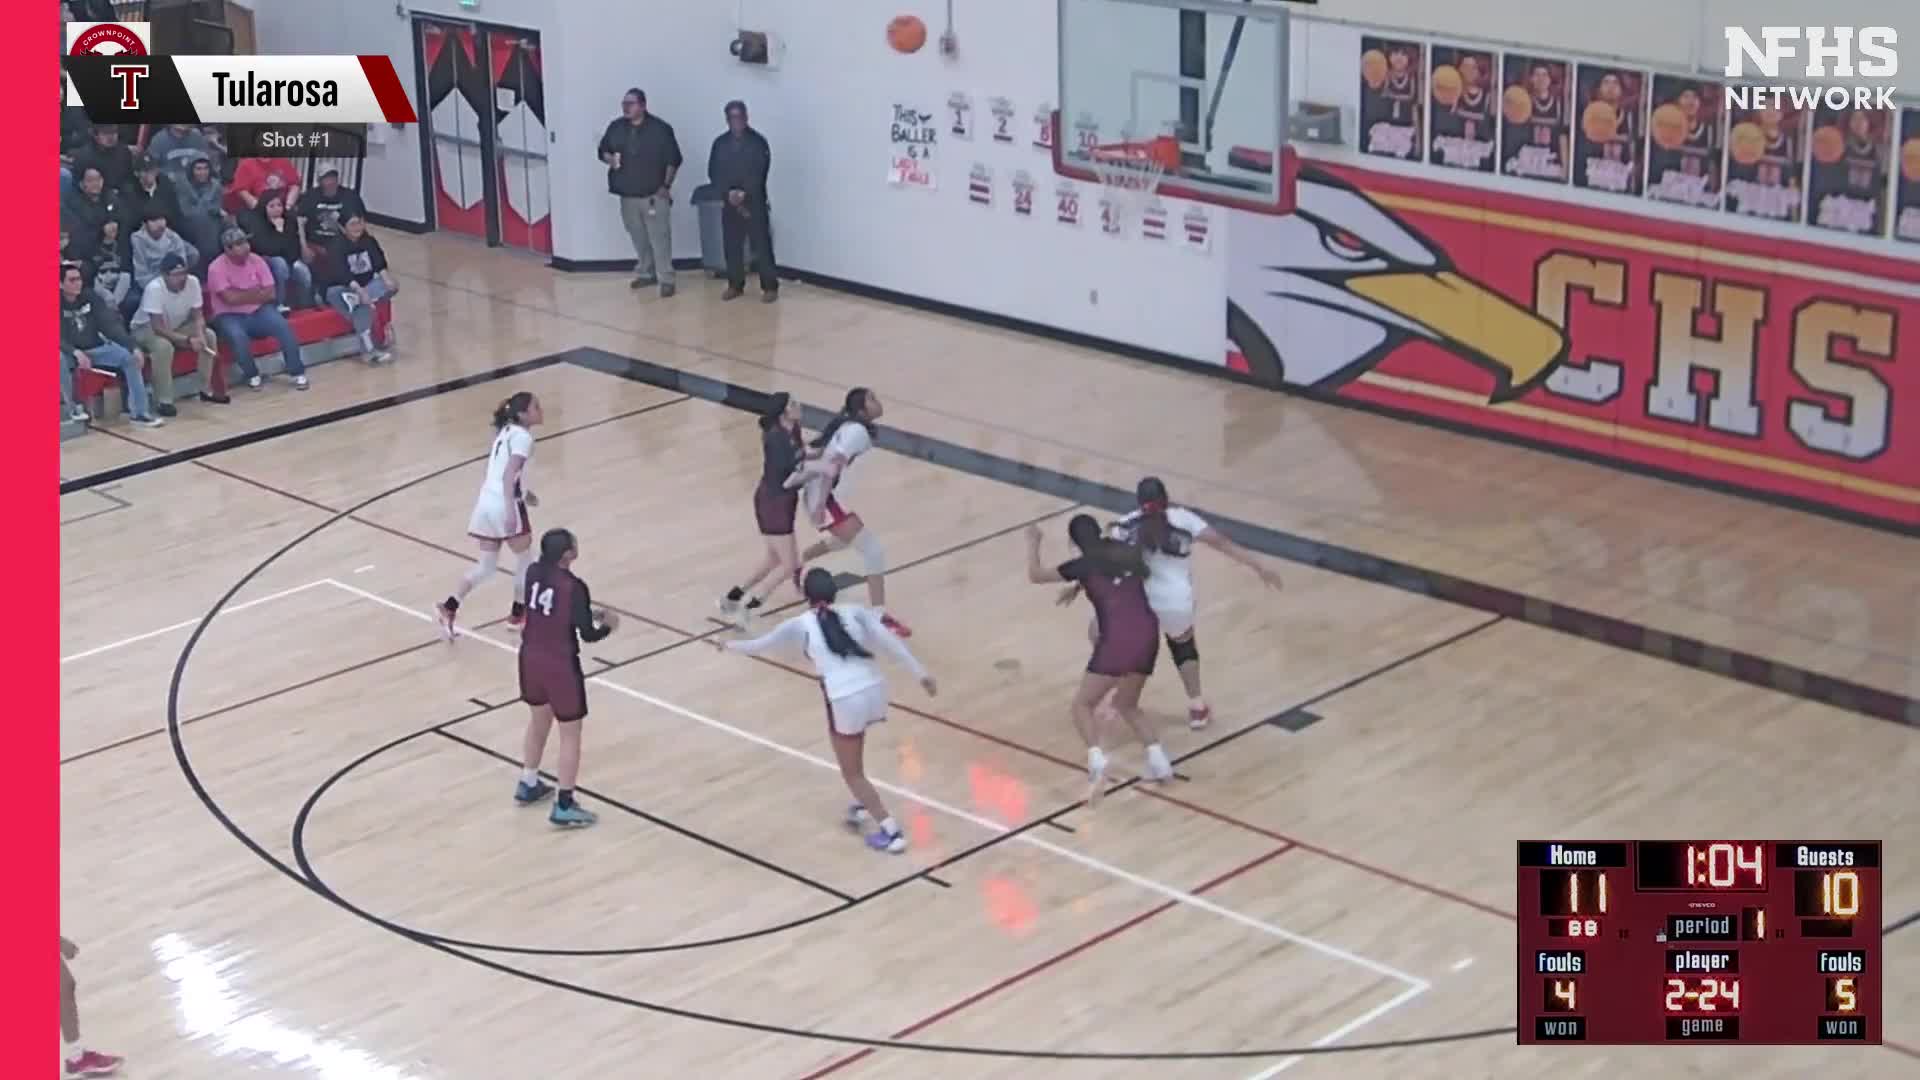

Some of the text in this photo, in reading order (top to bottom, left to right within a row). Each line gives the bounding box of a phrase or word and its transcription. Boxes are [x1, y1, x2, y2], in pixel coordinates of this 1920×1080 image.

[891, 123, 936, 144] BALLER
[1058, 198, 1078, 216] 40
[1534, 249, 1899, 463] CHS
[529, 581, 555, 616] 14
